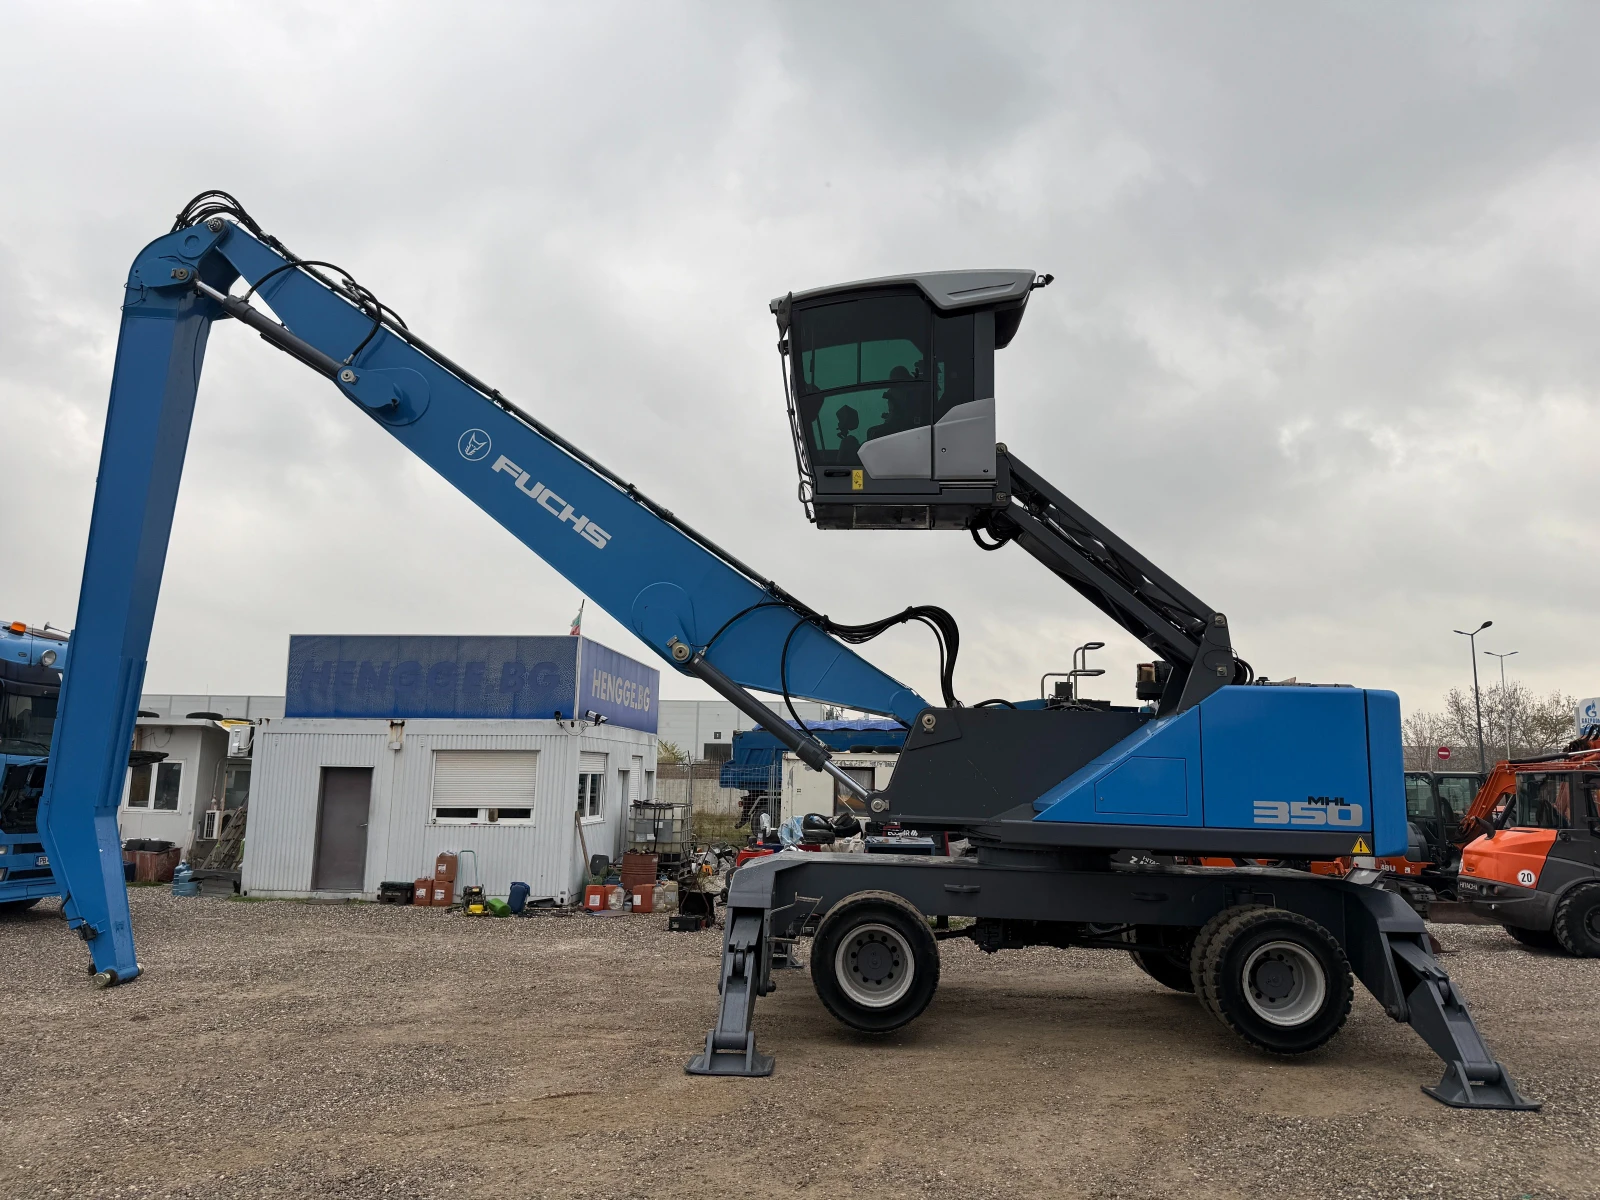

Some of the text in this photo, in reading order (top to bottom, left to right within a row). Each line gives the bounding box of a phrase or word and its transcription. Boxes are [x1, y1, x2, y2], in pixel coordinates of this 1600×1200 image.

[491, 454, 612, 550] FUCHS
[299, 660, 560, 694] HENGGE.BG
[592, 668, 650, 711] HENGGE.BG
[1254, 801, 1362, 826] 350
[1308, 796, 1350, 806] MHL
[1459, 881, 1478, 891] HITACHI
[1521, 873, 1532, 882] 20
